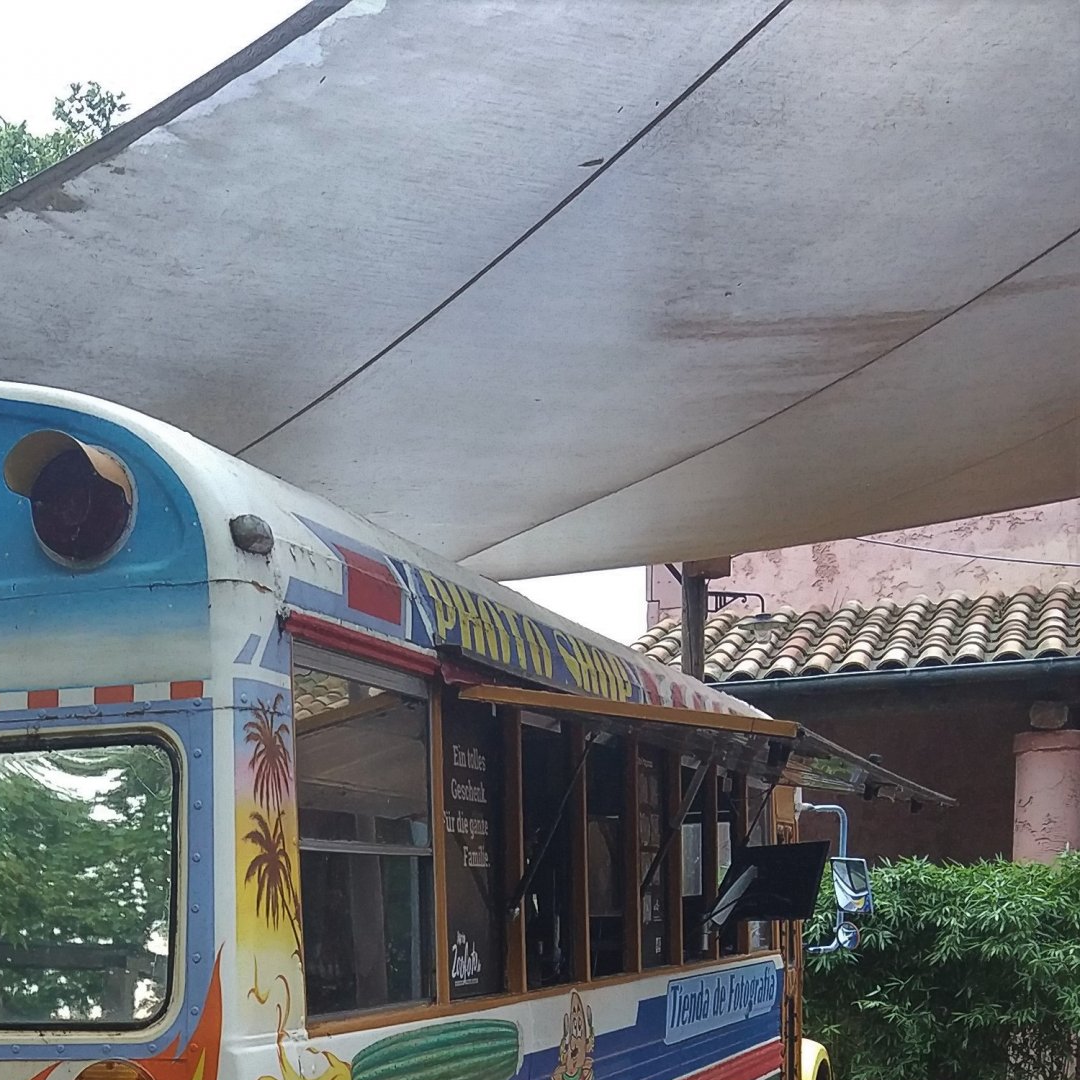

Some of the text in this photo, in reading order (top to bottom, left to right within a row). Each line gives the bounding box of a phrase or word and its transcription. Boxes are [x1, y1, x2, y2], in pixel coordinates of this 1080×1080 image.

[419, 567, 633, 702] PHOTO SHOP
[452, 744, 486, 771] Ein tolles
[456, 810, 469, 834] die
[469, 818, 488, 839] ganze
[670, 980, 710, 1029] Tienda
[712, 977, 726, 1017] de
